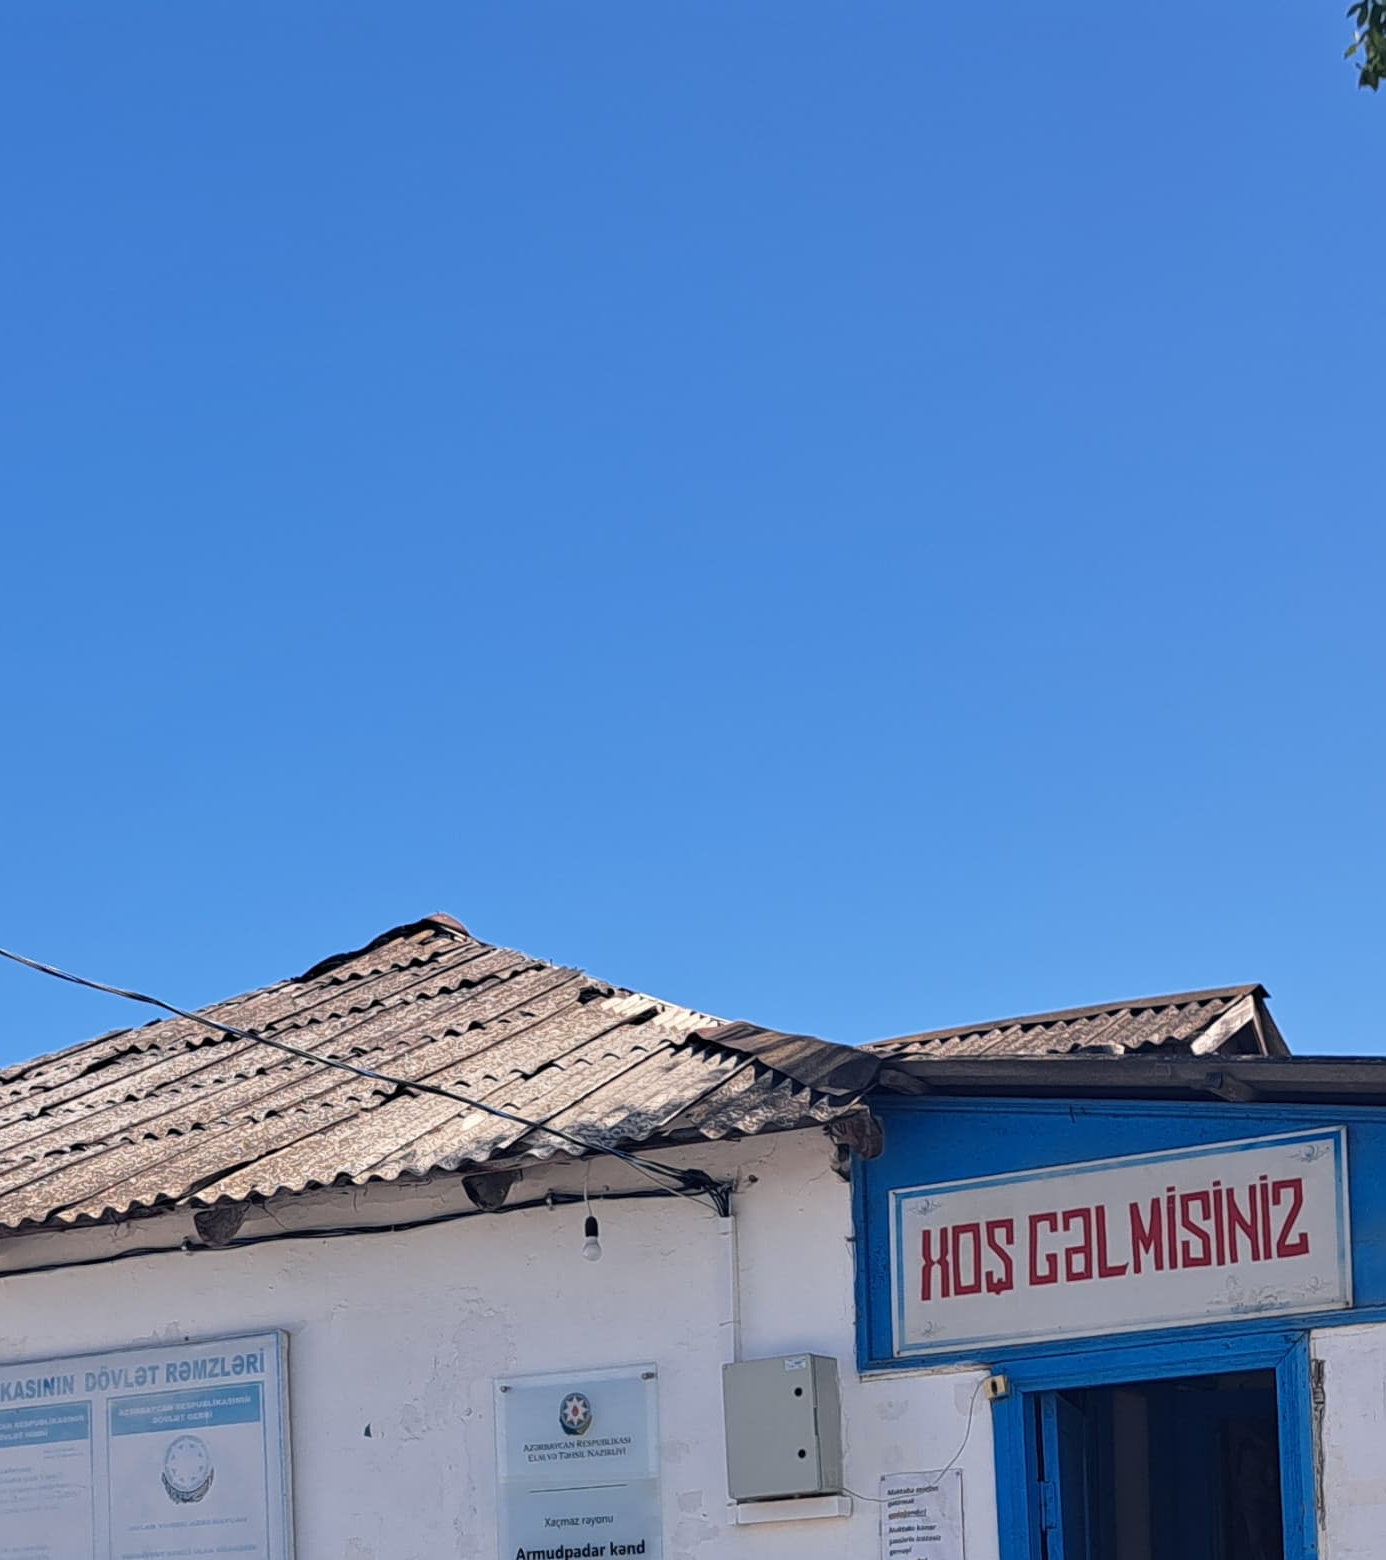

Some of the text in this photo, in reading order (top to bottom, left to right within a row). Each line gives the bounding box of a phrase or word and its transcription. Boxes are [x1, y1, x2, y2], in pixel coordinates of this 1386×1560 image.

[921, 1174, 1310, 1301] XOŞ GƏLMİSİNİZ
[85, 1365, 159, 1393] DÖVLƏT
[165, 1348, 265, 1384] RƏMZLƏRİ
[544, 1514, 614, 1529] Xaçmaz rayonu
[609, 1539, 646, 1556] kənd
